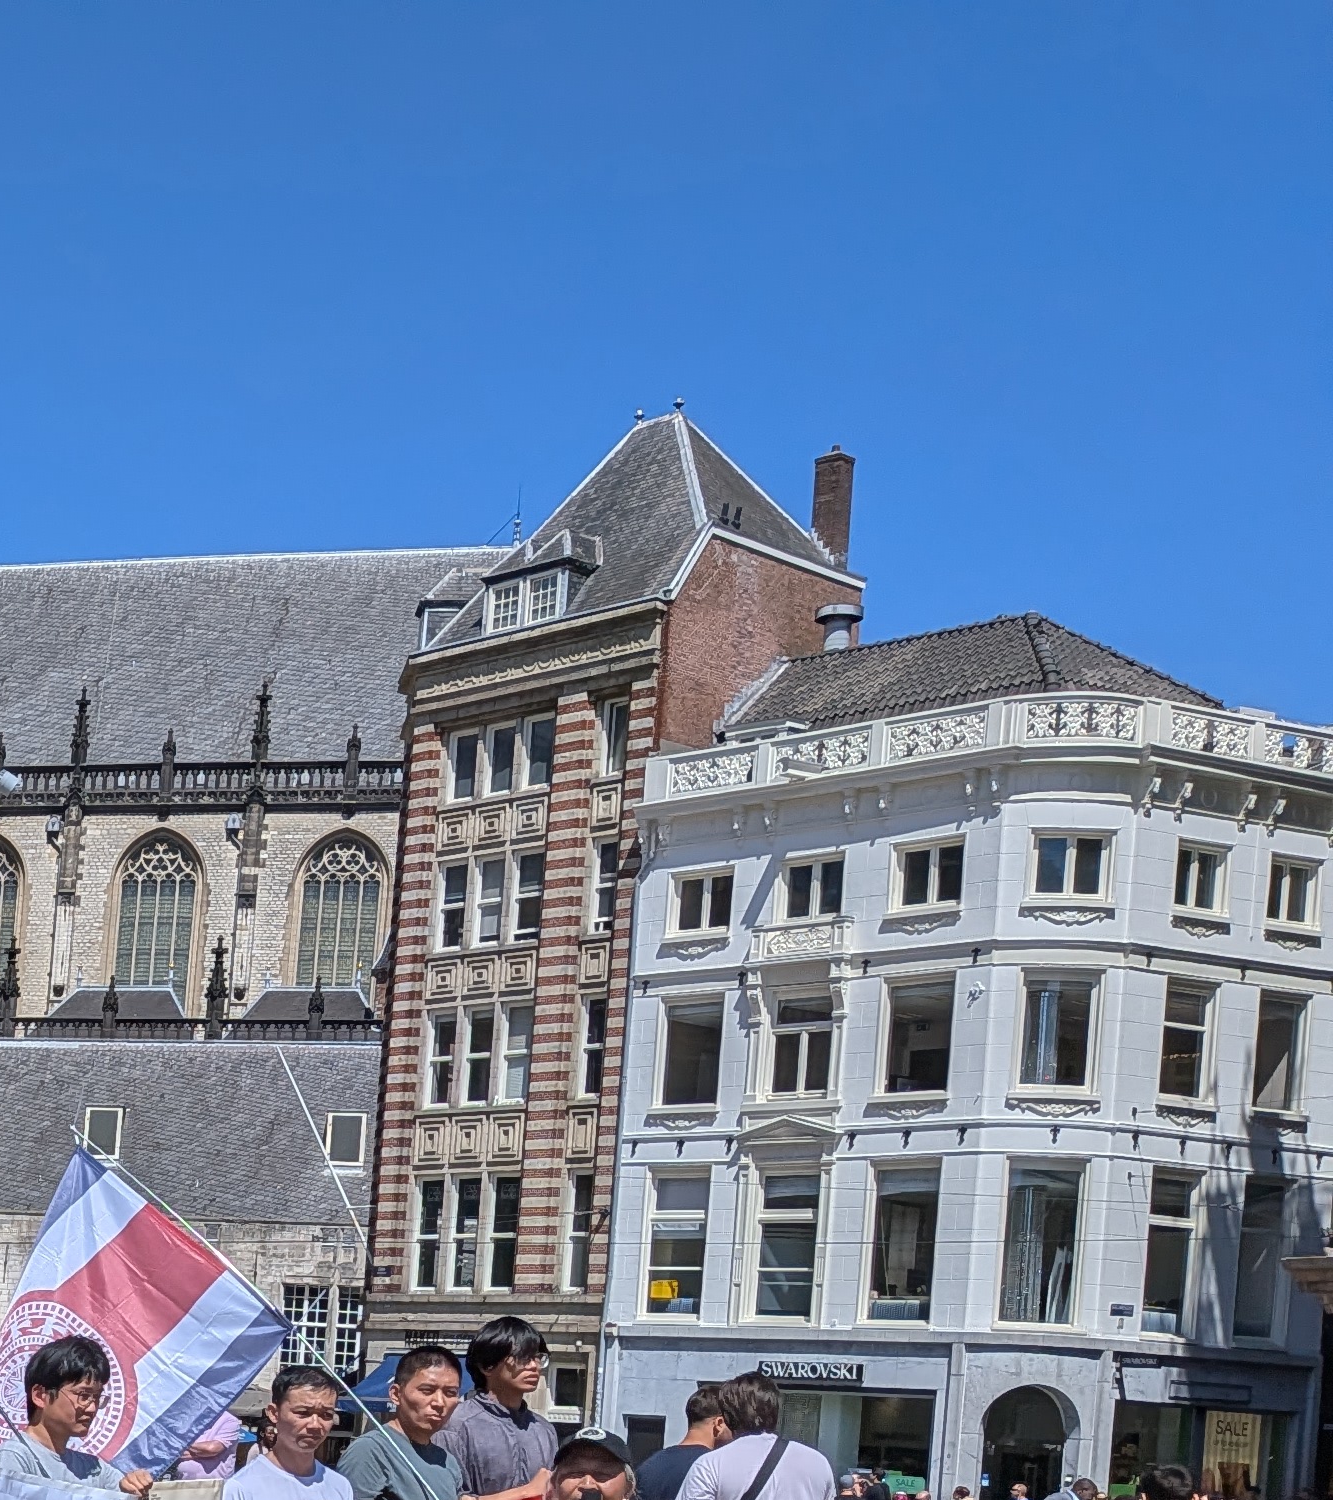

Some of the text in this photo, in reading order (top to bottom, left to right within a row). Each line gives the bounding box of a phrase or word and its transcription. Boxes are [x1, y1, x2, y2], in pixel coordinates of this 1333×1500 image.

[761, 1361, 857, 1379] SWAROVSKI
[1216, 1420, 1249, 1436] SALE
[895, 1479, 915, 1487] SALE
